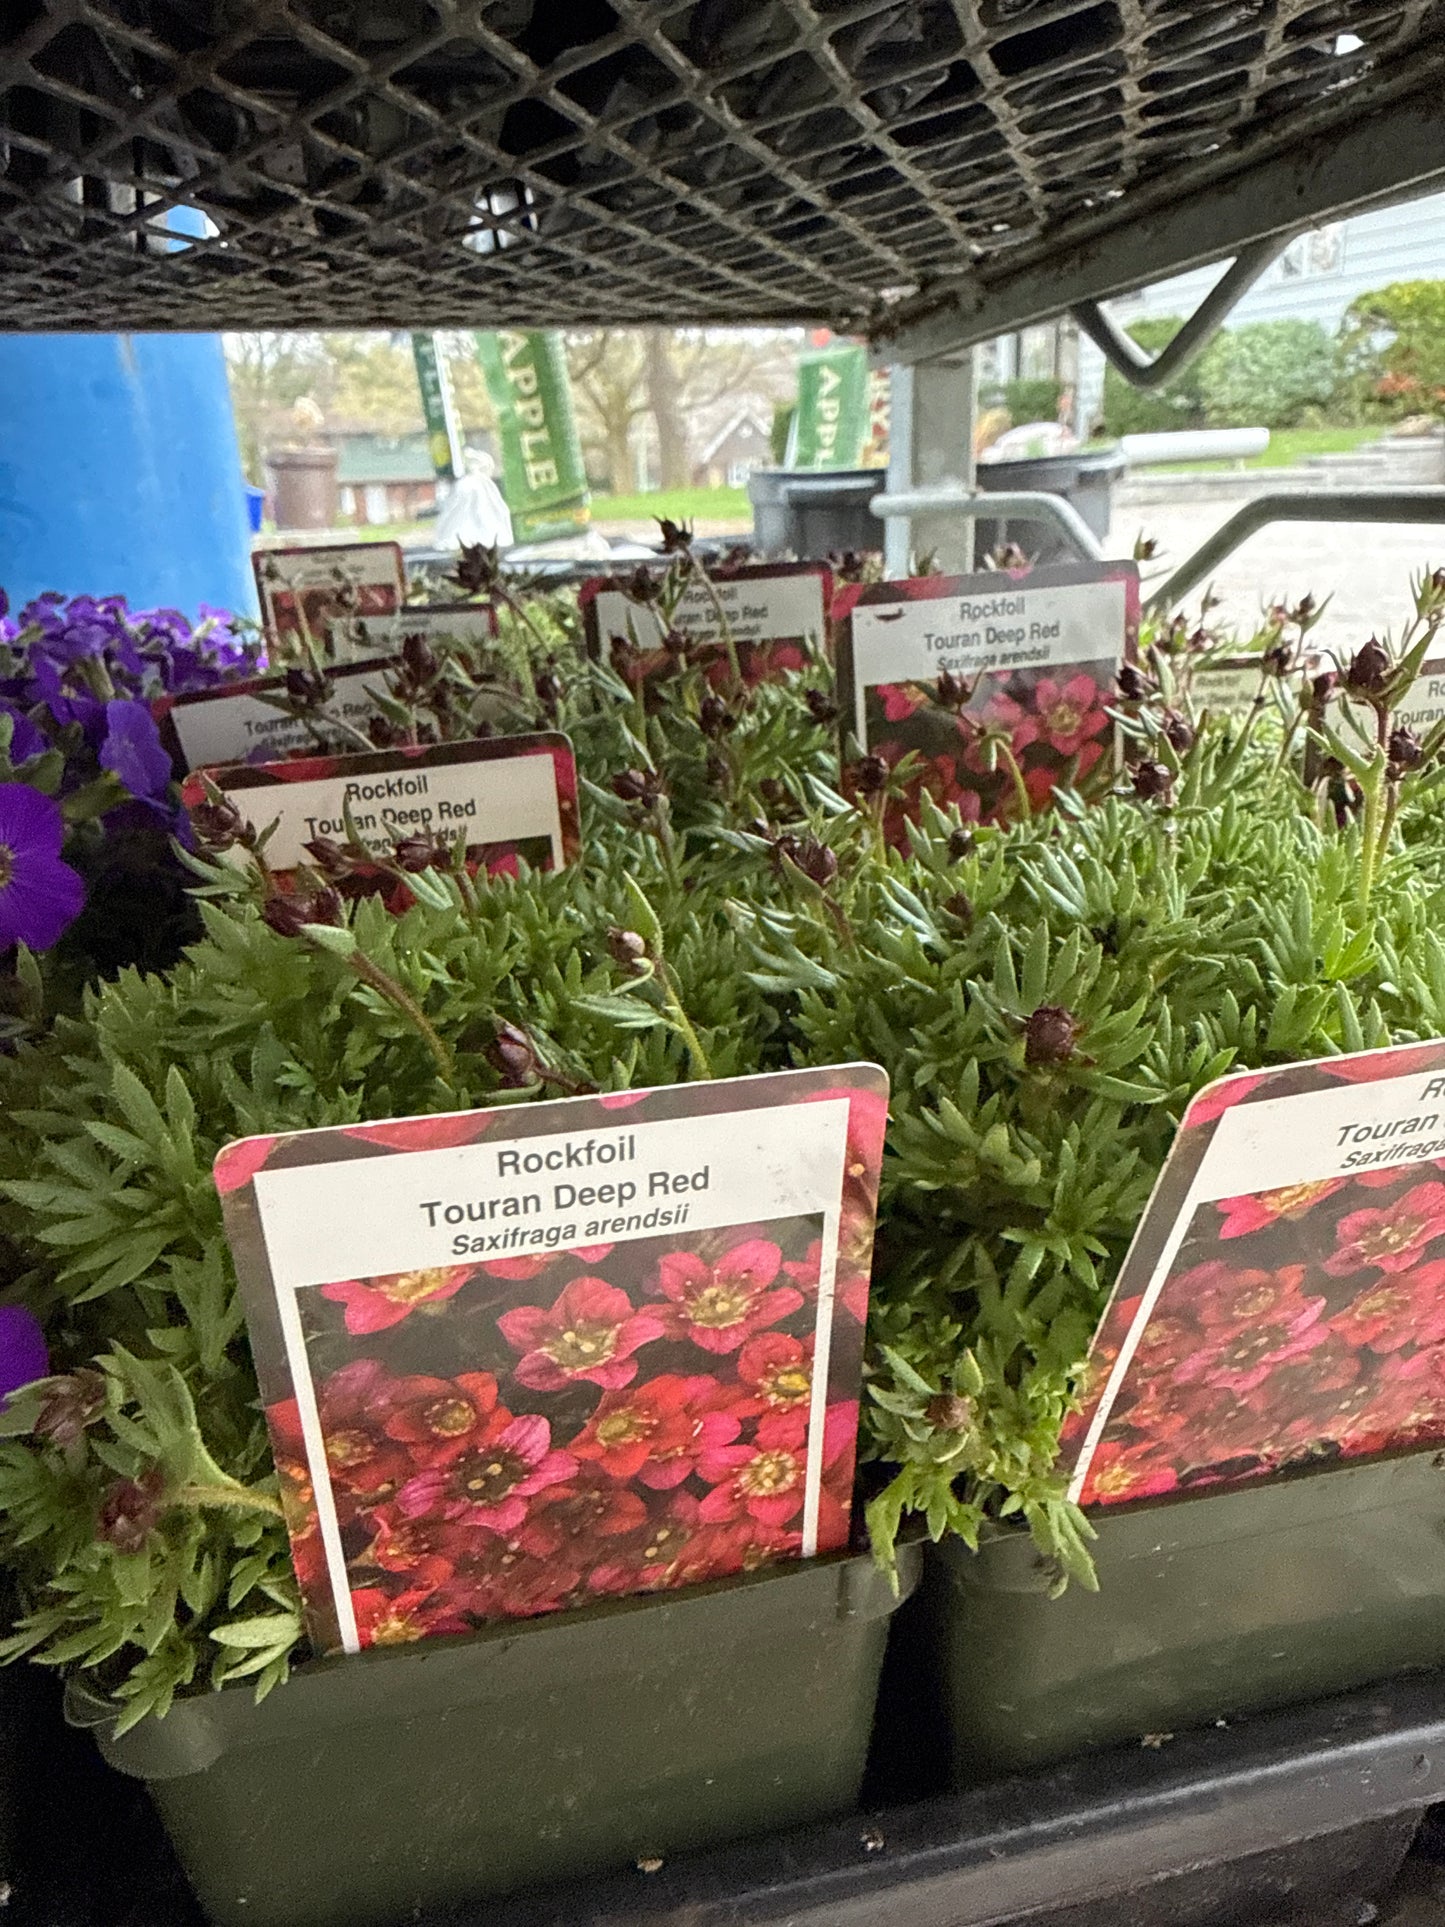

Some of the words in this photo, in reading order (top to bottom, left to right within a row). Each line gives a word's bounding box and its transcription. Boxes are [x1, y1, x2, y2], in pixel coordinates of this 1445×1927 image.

[497, 330, 559, 490] APPLE
[742, 605, 769, 619] Red
[960, 597, 1026, 621] Rockfoil
[924, 632, 981, 652] Touran
[986, 626, 1026, 645] Deep
[1029, 620, 1060, 640] Red
[345, 775, 429, 802] Rockfoil
[304, 812, 377, 840] Touan
[438, 798, 477, 819] Red
[1337, 1113, 1440, 1147] Touran
[497, 1134, 636, 1177] Rockfoil
[420, 1193, 541, 1227] Touran
[554, 1180, 637, 1210] Deep
[648, 1165, 710, 1197] Red
[452, 1223, 577, 1256] Saxifraga
[584, 1202, 690, 1237] arendsii
